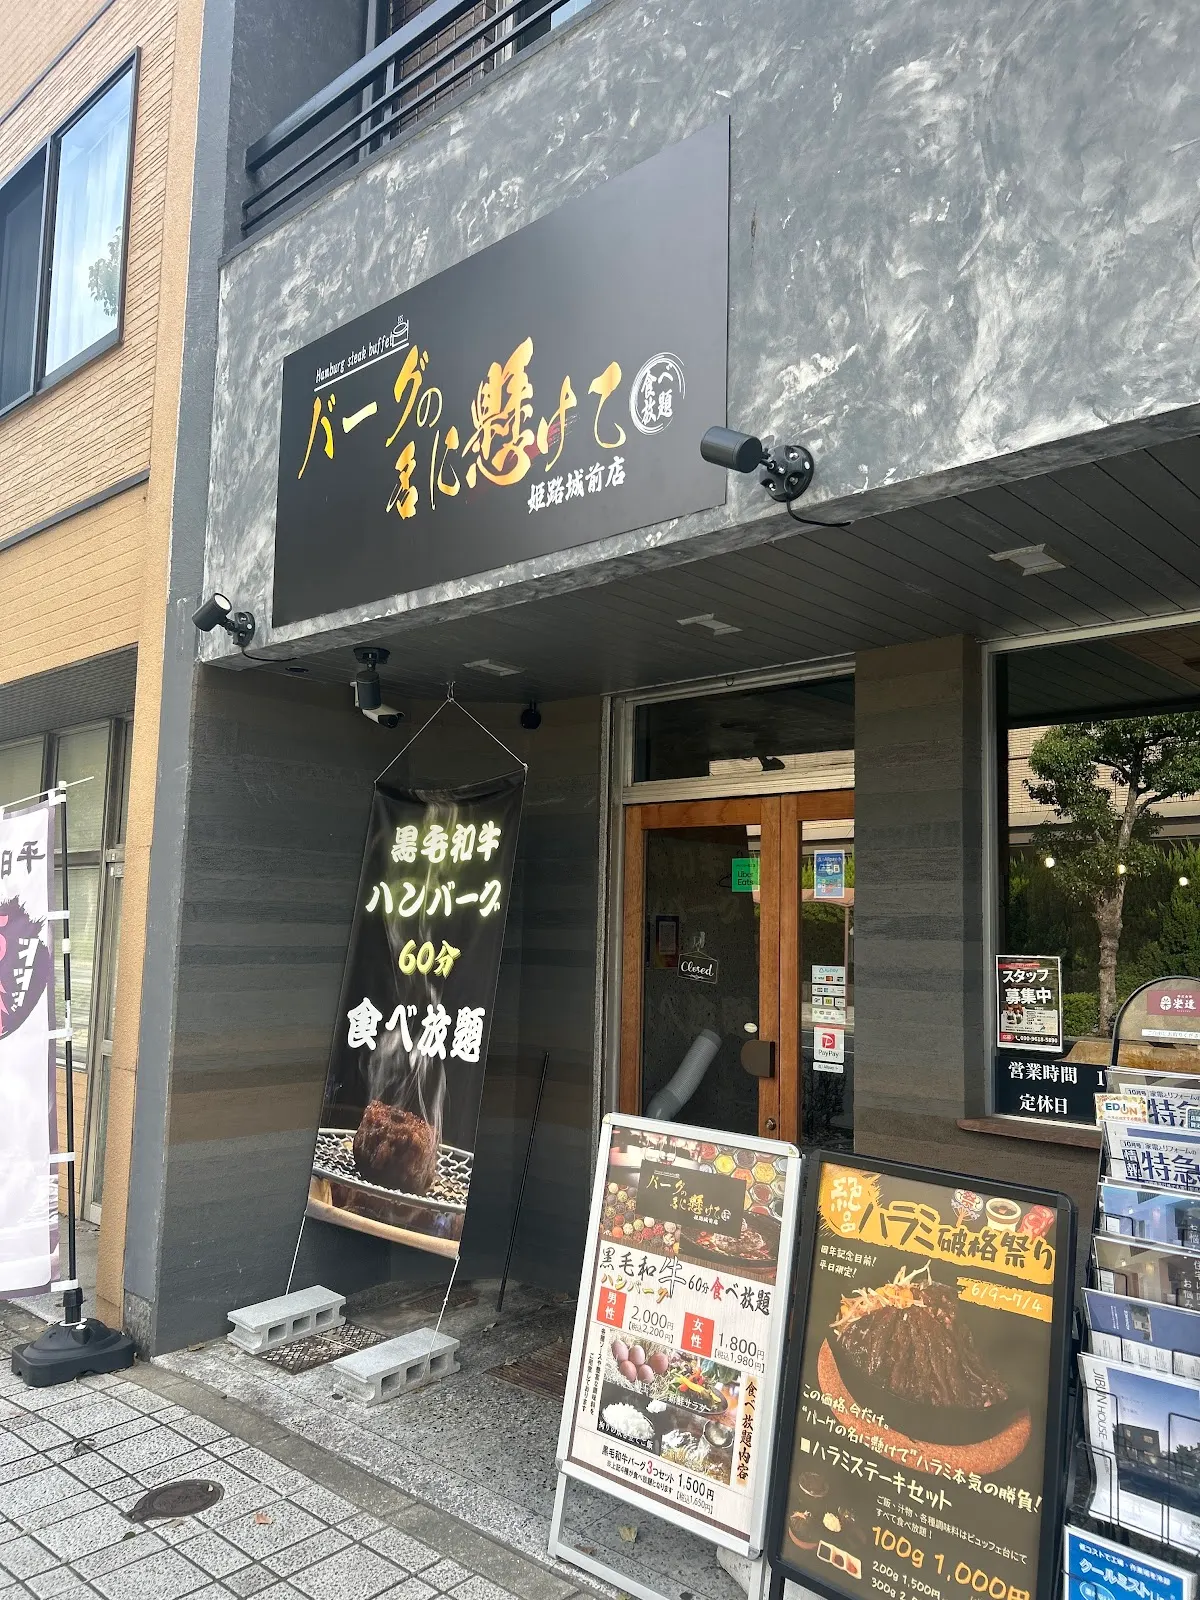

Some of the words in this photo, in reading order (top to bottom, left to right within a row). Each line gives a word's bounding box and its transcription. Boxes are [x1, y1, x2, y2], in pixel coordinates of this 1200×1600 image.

[315, 359, 345, 384] Hamburg
[347, 350, 367, 367] steak
[368, 331, 394, 357] buffet
[297, 344, 443, 479] バーグの
[385, 335, 627, 520] 名に懸けて
[527, 455, 626, 514] 姫路城前店
[390, 820, 502, 864] 黒毛和牛
[737, 870, 754, 878] Uber
[737, 878, 754, 886] Eats
[365, 879, 502, 918] ハンバーグ
[398, 939, 461, 978] 60分
[680, 960, 714, 977] Closed
[1002, 968, 1049, 984] スタッフ
[1004, 986, 1052, 1005] 募集中
[346, 997, 486, 1063] 食べ放題
[818, 1048, 839, 1059] PayPay
[1007, 1061, 1078, 1085] 営業時間
[1019, 1094, 1068, 1115] 定休日
[1105, 1102, 1138, 1116] EDION
[646, 1174, 687, 1196] バーグの
[858, 1202, 1053, 1271] ハラミ破格祭り
[599, 1247, 687, 1299] 黒毛和牛
[688, 1275, 710, 1294] 60分
[710, 1276, 772, 1316] 食べ放題
[819, 1259, 858, 1278] 平日限定!
[600, 1272, 670, 1304] ハンバーグ
[604, 1291, 617, 1321] 男性
[630, 1305, 674, 1331] 2,000円
[690, 1318, 704, 1349] 女性
[718, 1332, 765, 1360] 1,800円
[1092, 1368, 1108, 1404] JIBUN
[803, 1383, 889, 1430] この価格、今だけ。
[736, 1381, 758, 1481] 食べ放題内容
[1097, 1405, 1108, 1441] HOUSE
[678, 1473, 714, 1502] 1,500円
[872, 1526, 925, 1569] 100g
[934, 1553, 1030, 1600] 1,000円
[871, 1577, 896, 1599] 300g
[872, 1560, 899, 1582] 200g
[902, 1574, 940, 1600] 1,500円
